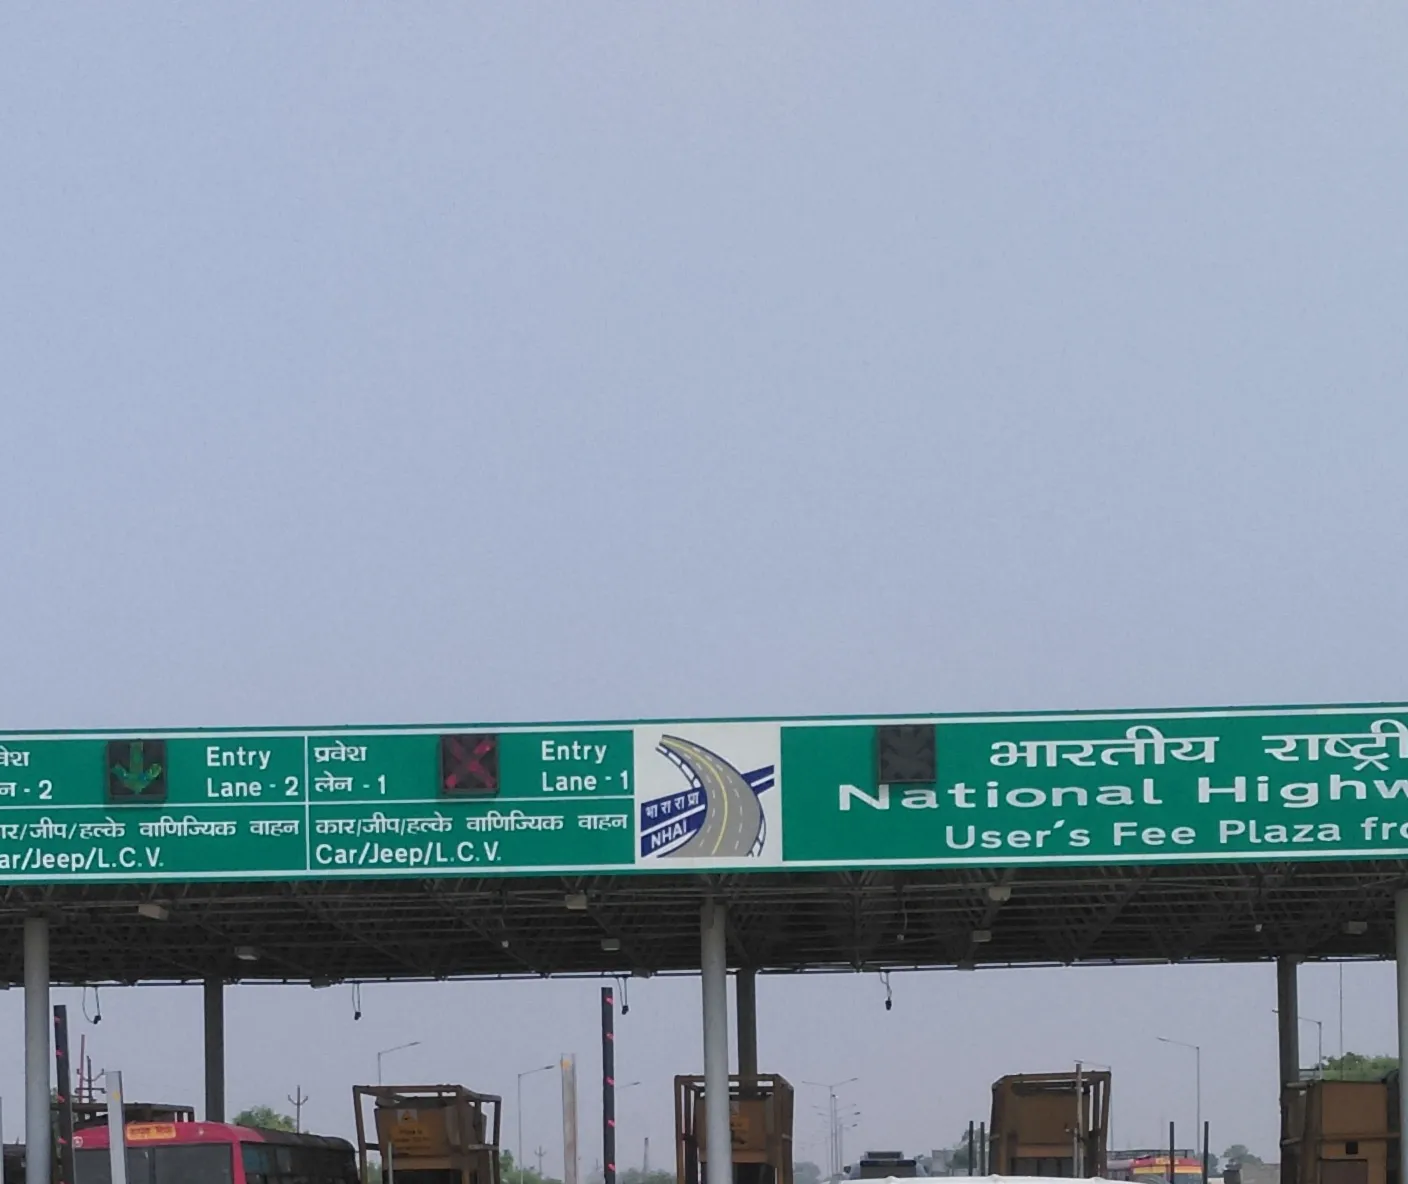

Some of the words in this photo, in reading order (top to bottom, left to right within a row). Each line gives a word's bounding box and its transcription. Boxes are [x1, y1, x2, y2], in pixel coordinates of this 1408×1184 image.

[206, 746, 271, 770] Entry
[314, 739, 368, 763] प्रवेश
[541, 740, 607, 764] Entry
[990, 725, 1220, 767] भारतीय
[38, 780, 53, 800] 2
[207, 777, 262, 798] Lane
[284, 776, 299, 796] 2
[315, 771, 354, 793] लेन
[377, 774, 386, 795] 1
[542, 771, 597, 792] Lane
[620, 769, 629, 790] 1
[838, 778, 1163, 811] National
[139, 815, 236, 838] वाणिज्यिक
[250, 820, 300, 837] वाहन
[316, 812, 452, 836] कार/जीप/हल्के
[466, 810, 564, 832] वाणिज्यिक
[578, 813, 628, 830] वाहन
[651, 819, 687, 849] NHAI
[945, 819, 1091, 850] User's
[1113, 822, 1197, 846] Fee
[1219, 819, 1342, 844] Plaza
[315, 841, 502, 867] Car/Jeep/L.C.V.
